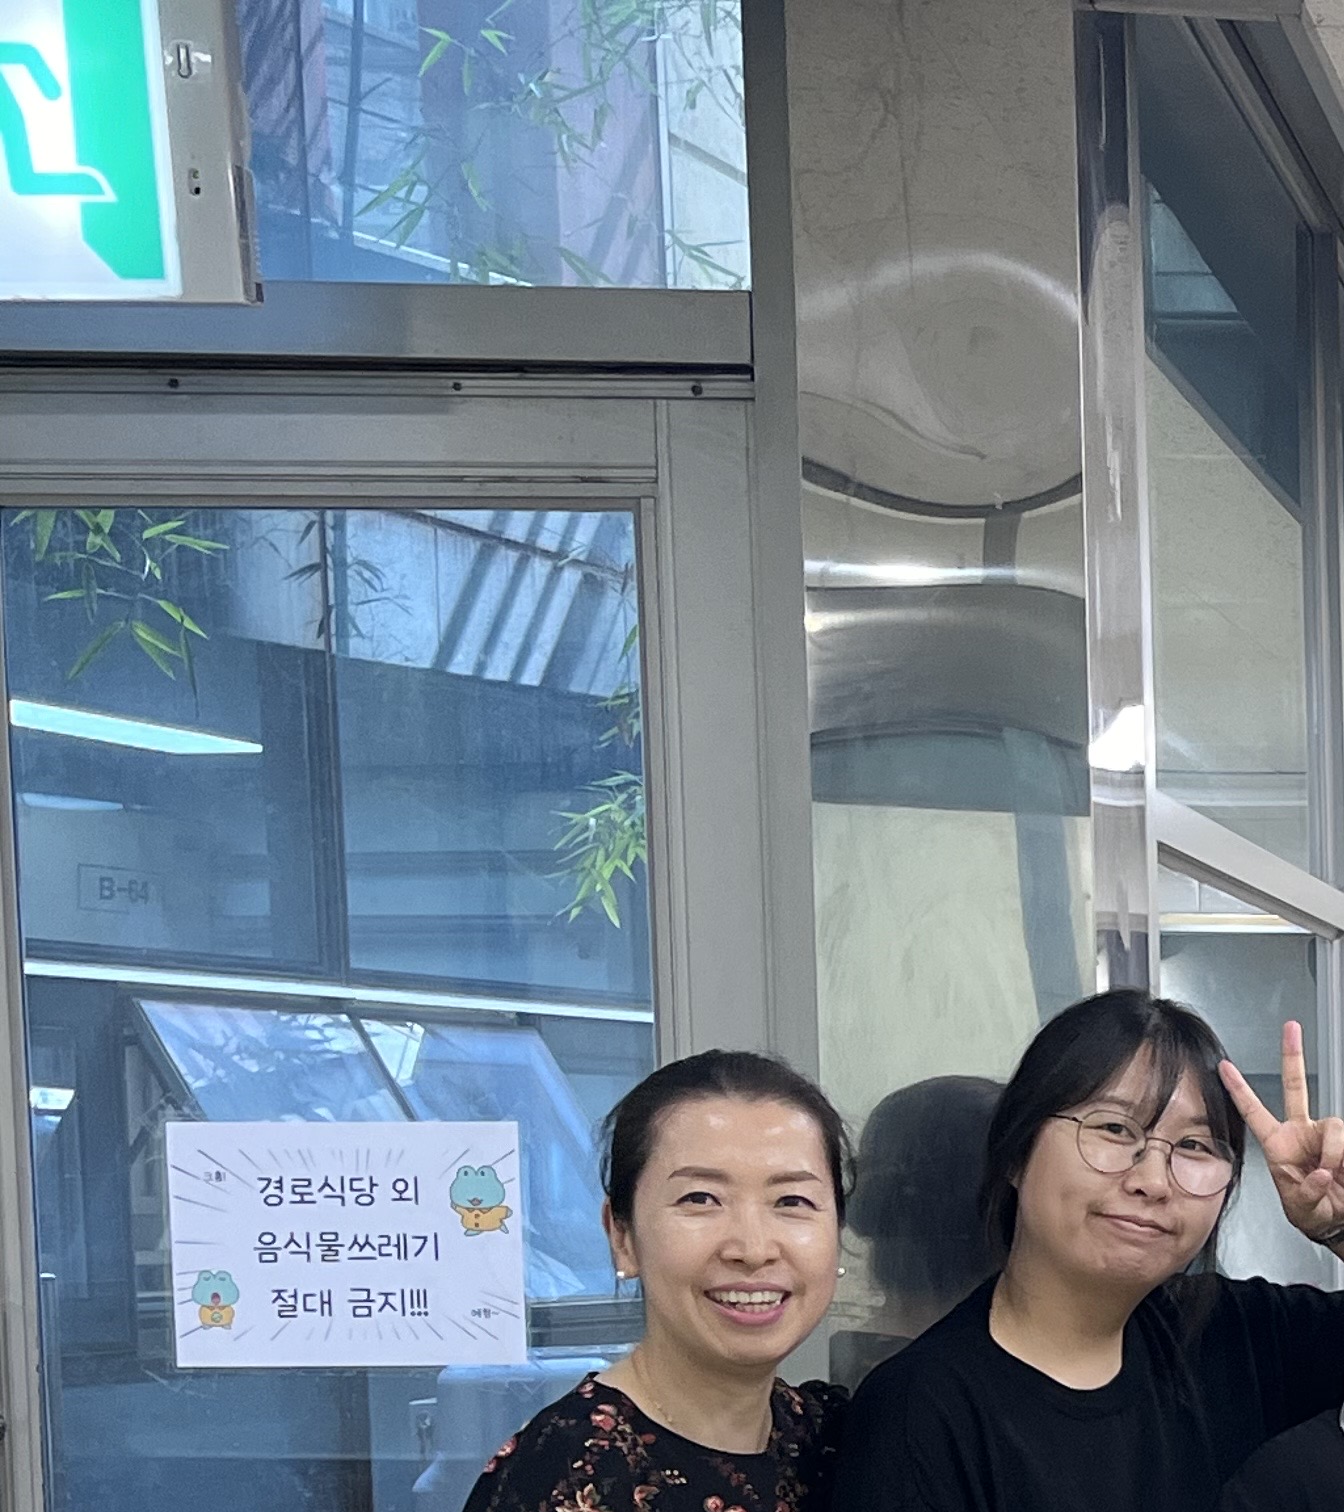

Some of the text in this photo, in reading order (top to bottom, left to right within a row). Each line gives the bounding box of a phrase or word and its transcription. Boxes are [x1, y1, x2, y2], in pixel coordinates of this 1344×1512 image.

[257, 1175, 419, 1207] 경로식당 외
[253, 1231, 440, 1263] 음식물쓰레기
[271, 1288, 429, 1319] 절대 금지!!!
